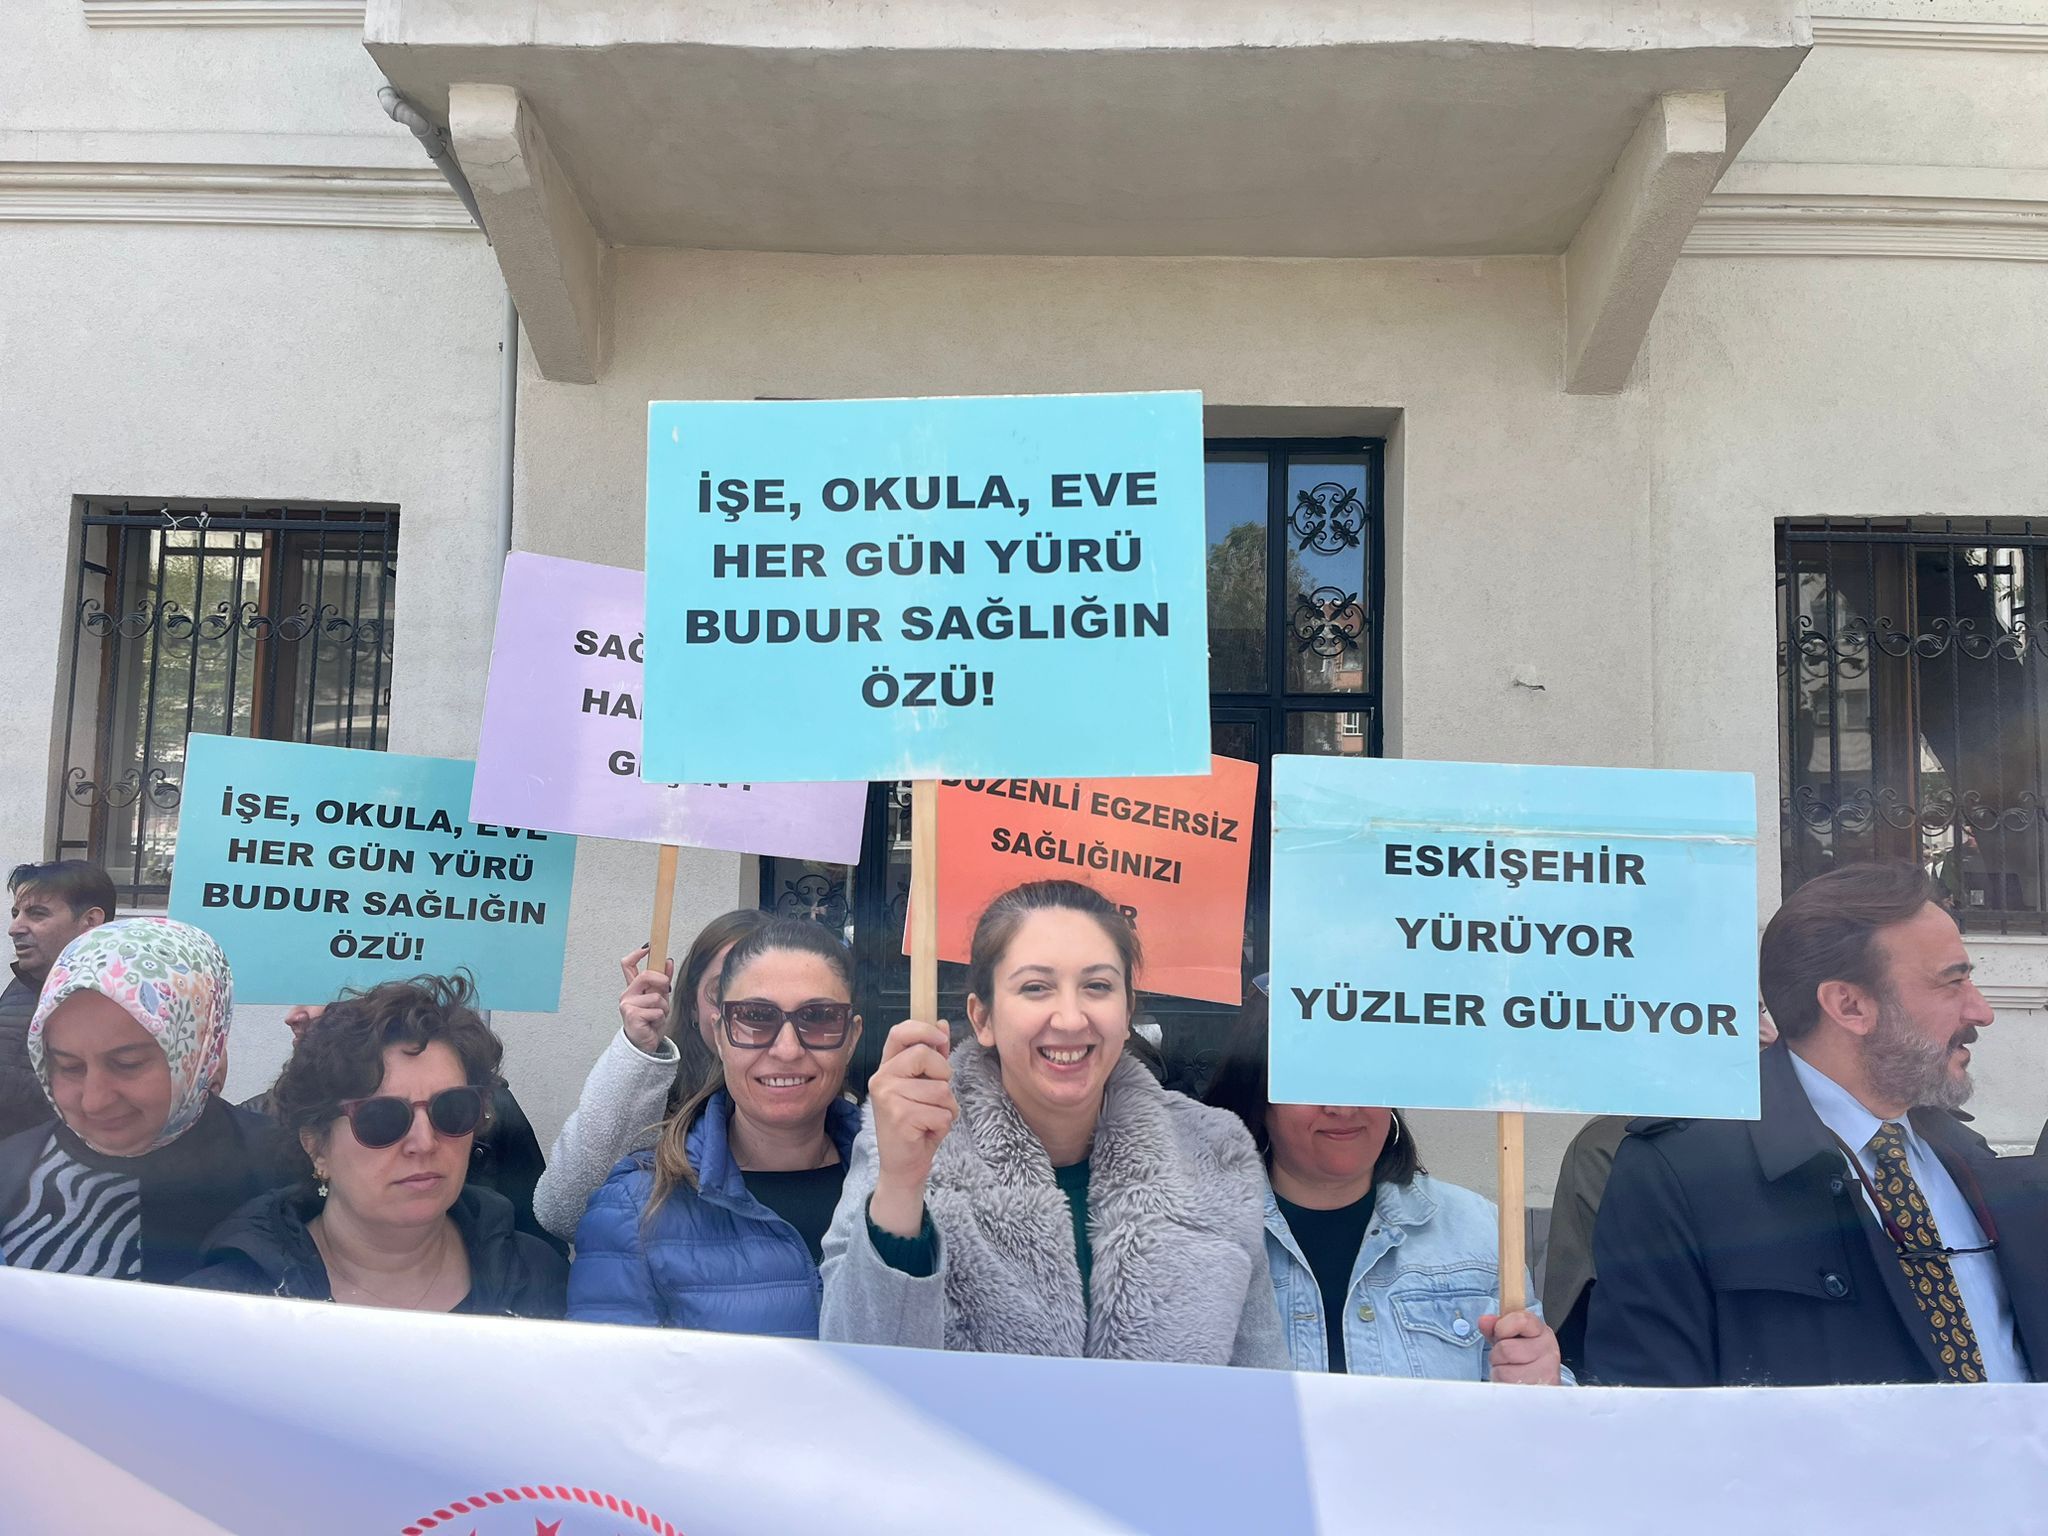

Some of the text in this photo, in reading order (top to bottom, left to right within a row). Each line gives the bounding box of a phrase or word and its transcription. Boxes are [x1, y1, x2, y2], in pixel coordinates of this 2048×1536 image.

[699, 471, 1158, 522] İŞE, OKULA, EVE
[713, 530, 1141, 578] HER GÜN YÜRÜ
[686, 596, 1169, 644] BUDUR SAĞLIĞIN
[582, 687, 643, 721] HA
[862, 664, 994, 708] ÖZÜ!
[221, 785, 300, 827] İŞE,
[315, 800, 463, 840] OKULA,
[1091, 791, 1239, 843] EGZERSİZ
[228, 838, 534, 882] HER GÜN YÜRÜ
[991, 828, 1182, 885] SAĞLIĞINIZI
[1385, 840, 1646, 888] ESKİŞEHİR
[202, 883, 546, 925] BUDUR SAĞLIĞIN
[329, 929, 425, 961] ÖZÜ!
[1395, 912, 1635, 959] YÜRÜYOR
[1291, 982, 1739, 1036] YÜZLER GÜLÜYOR
